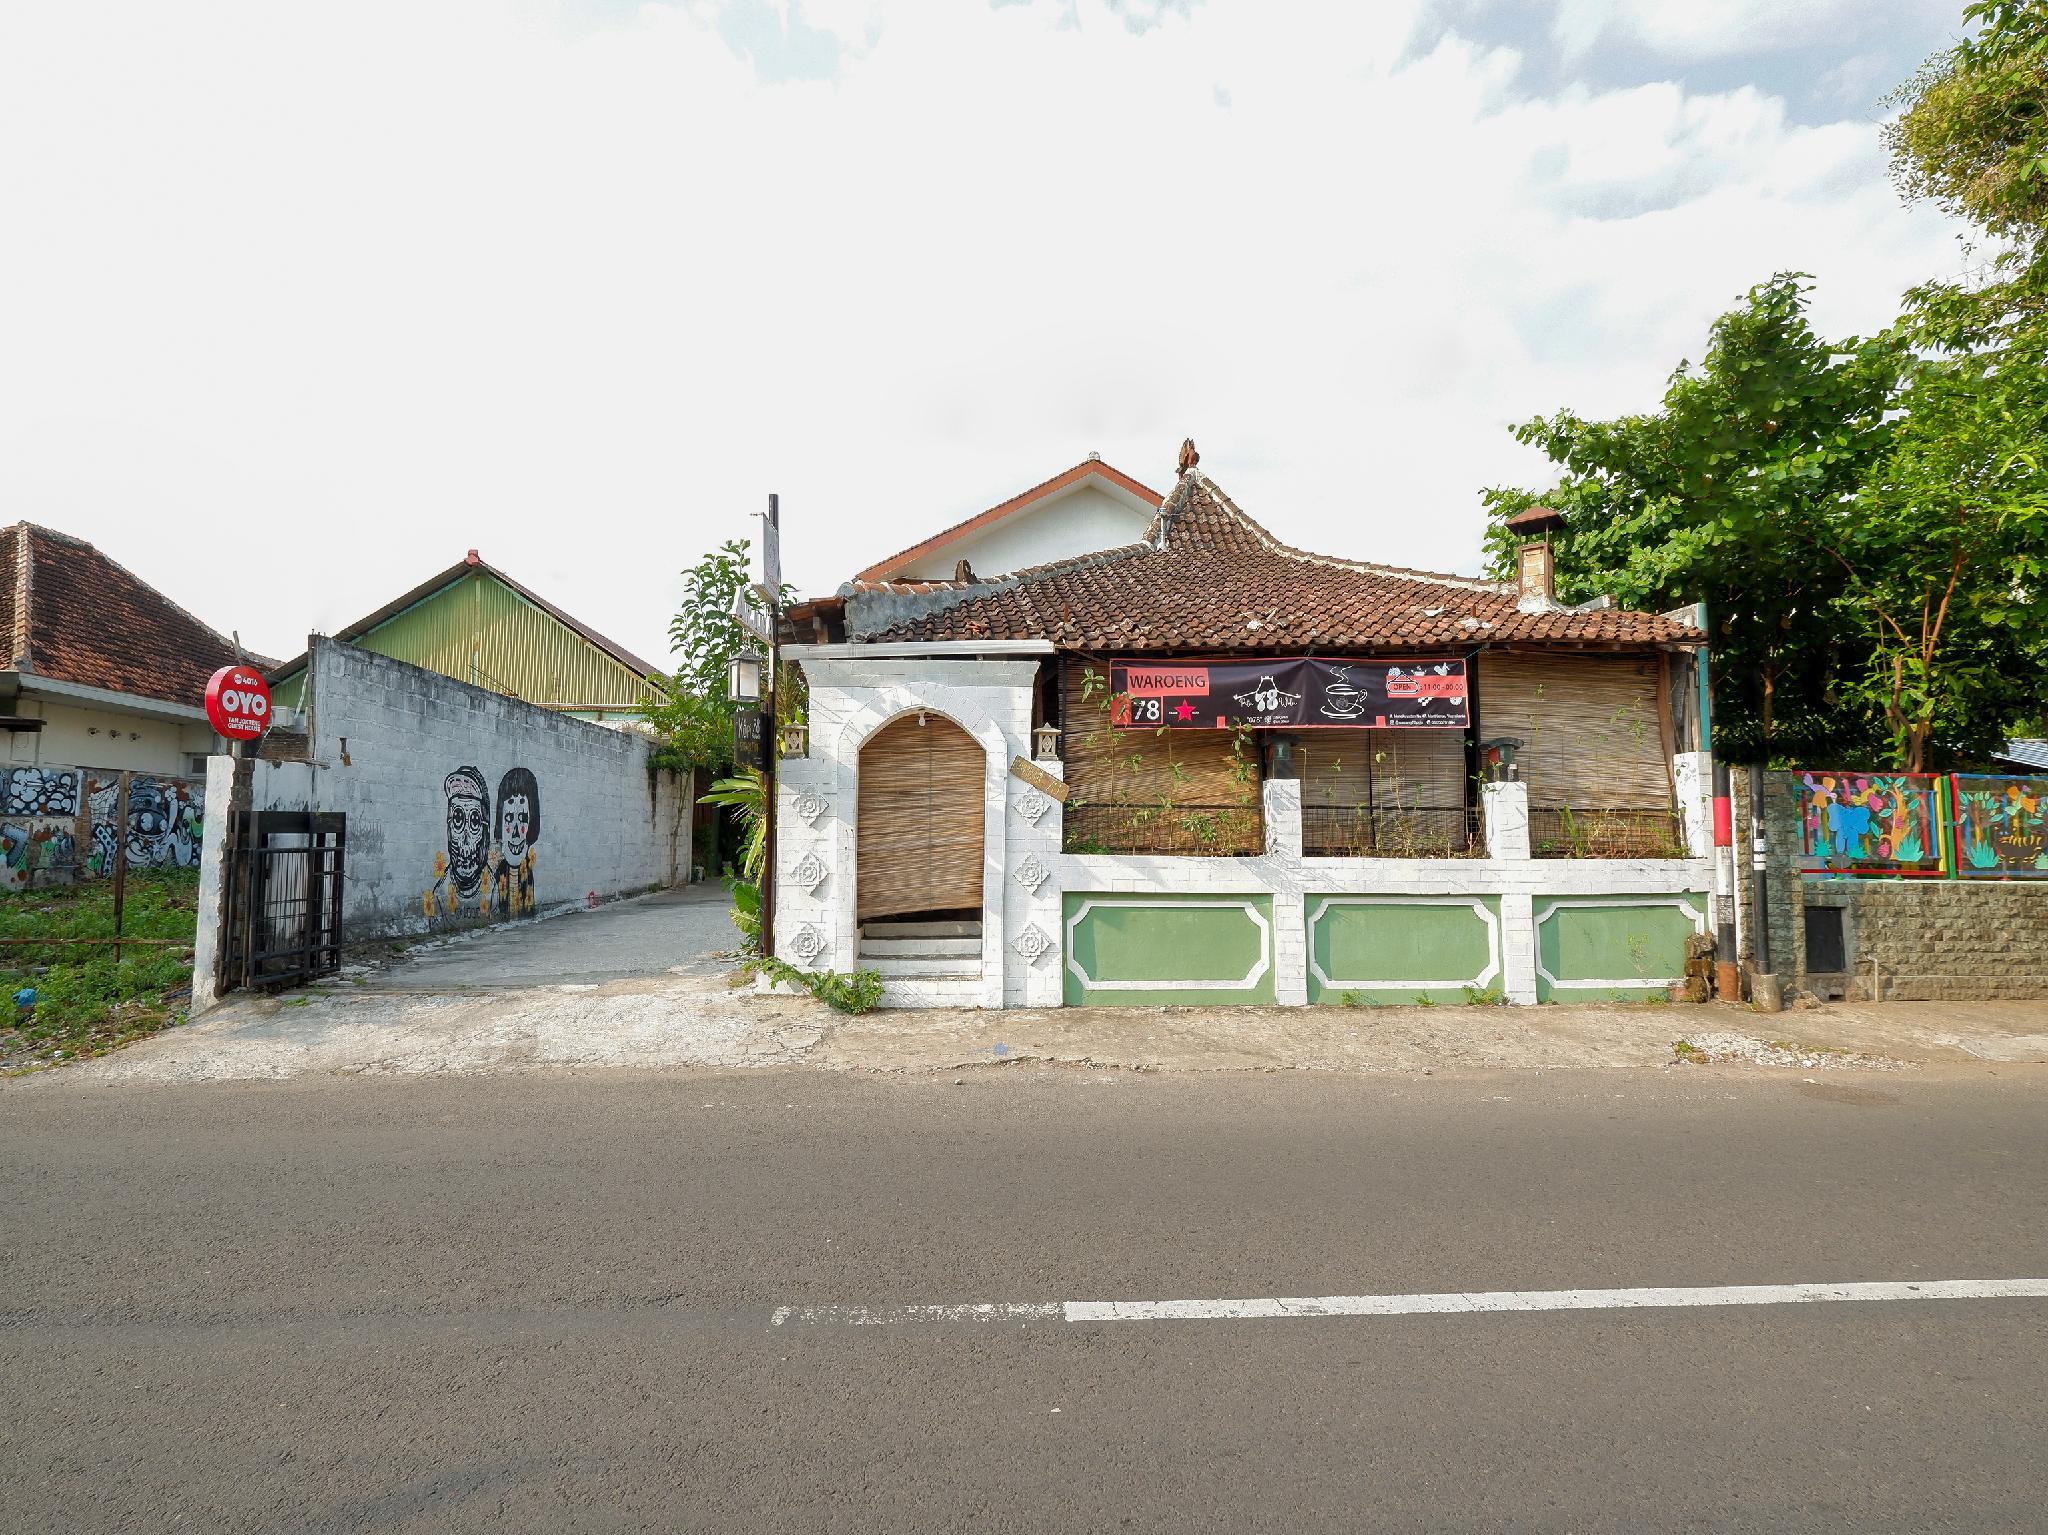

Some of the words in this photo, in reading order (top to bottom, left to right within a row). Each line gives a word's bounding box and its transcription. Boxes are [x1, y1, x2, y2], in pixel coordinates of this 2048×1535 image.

[1129, 675, 1206, 689] WAROENG
[222, 689, 267, 716] OYO
[1133, 700, 1160, 720] 78
